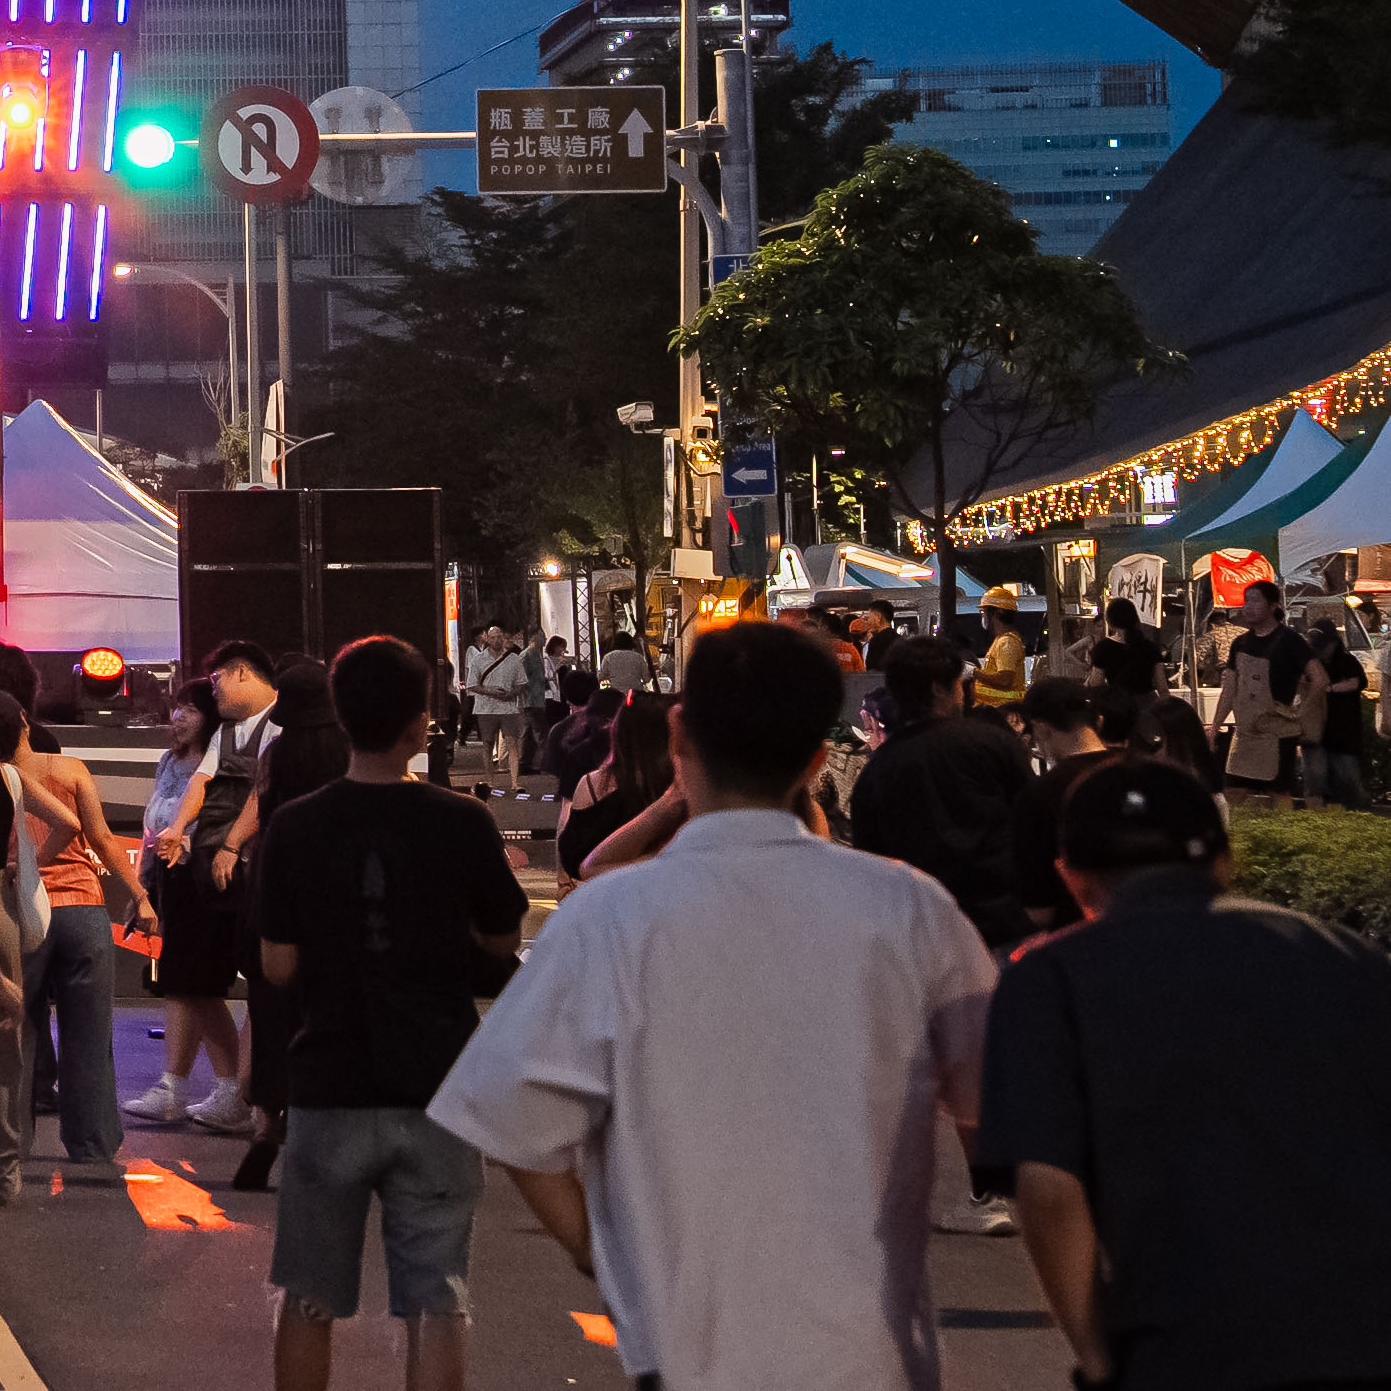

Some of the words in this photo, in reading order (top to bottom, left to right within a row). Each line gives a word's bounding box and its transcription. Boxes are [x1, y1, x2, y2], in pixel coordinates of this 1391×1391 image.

[490, 106, 610, 130] 瓶蓋工廠
[490, 135, 613, 159] 台北製造所
[490, 165, 547, 175] POPOP
[555, 163, 611, 175] TAIPEI
